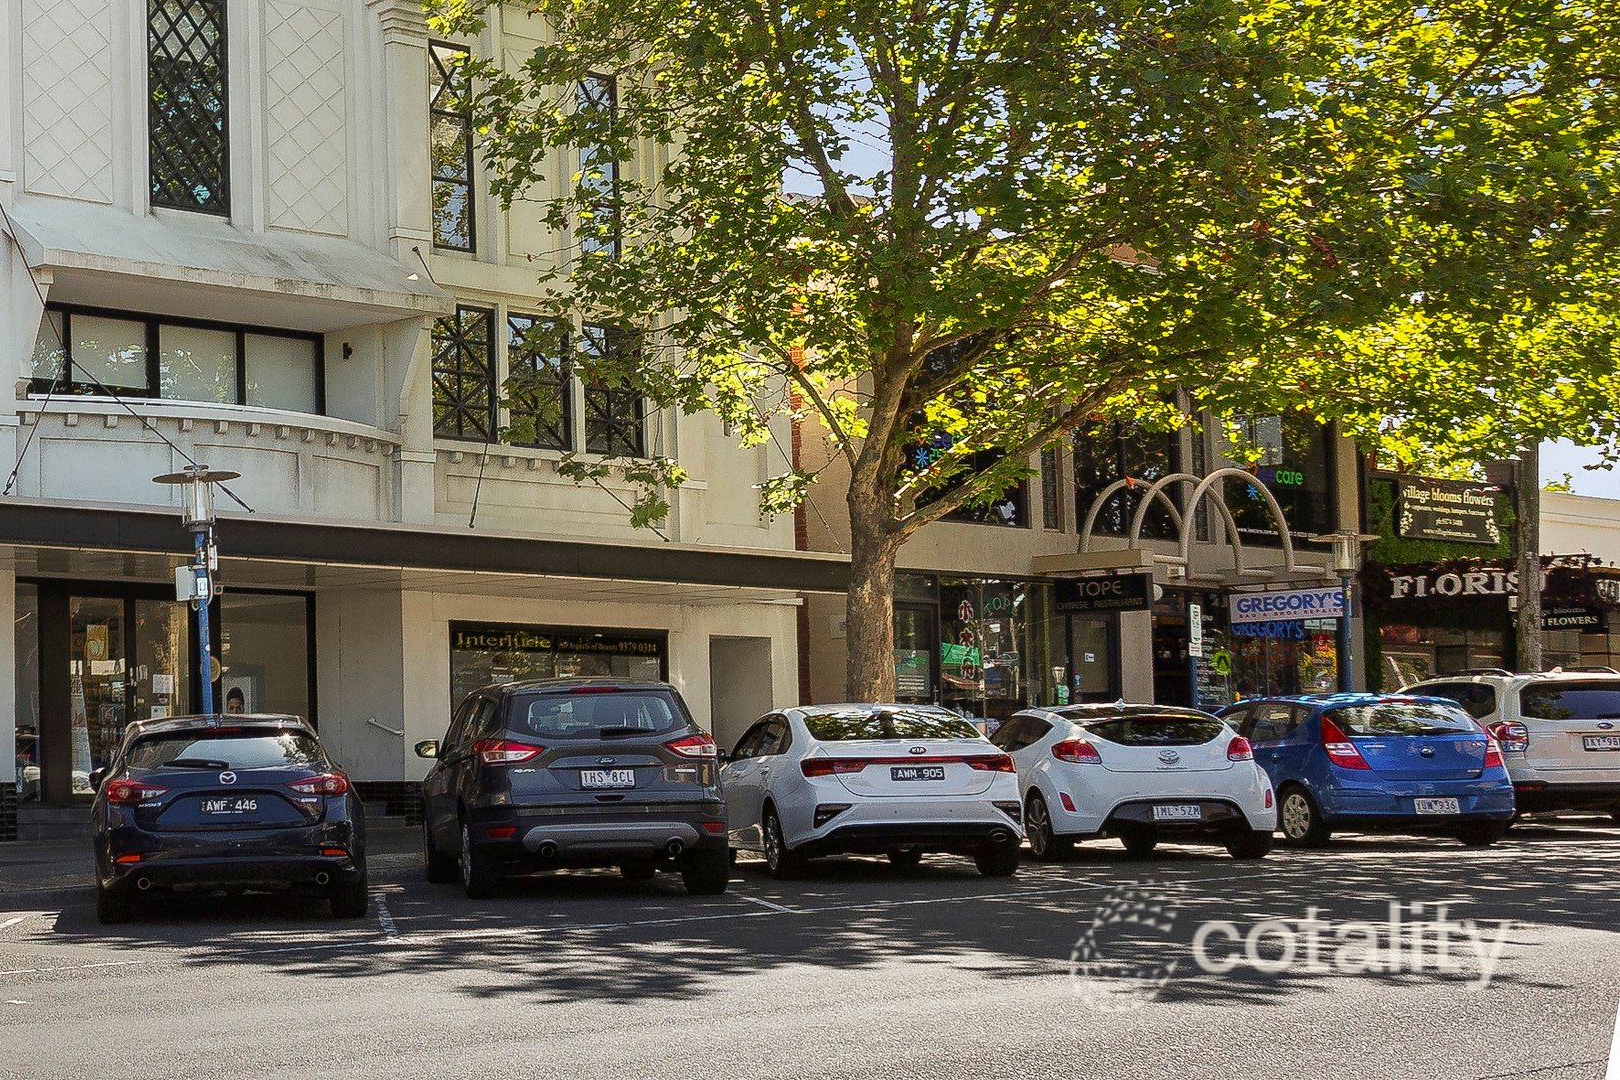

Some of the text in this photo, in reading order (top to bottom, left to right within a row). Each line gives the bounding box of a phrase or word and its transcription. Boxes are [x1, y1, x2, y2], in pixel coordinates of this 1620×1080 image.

[1403, 485, 1494, 506] village blooms flowers
[1076, 580, 1123, 596] TOPE
[1390, 570, 1546, 598] FLORIS
[1237, 591, 1343, 613] GREGORY'S
[1547, 615, 1598, 626] FLOWERS
[1231, 621, 1304, 638] GREGORY'S
[458, 632, 552, 648] Interlude
[583, 771, 633, 783] 1HS 8CL
[923, 769, 943, 778] 905
[235, 800, 257, 810] 446
